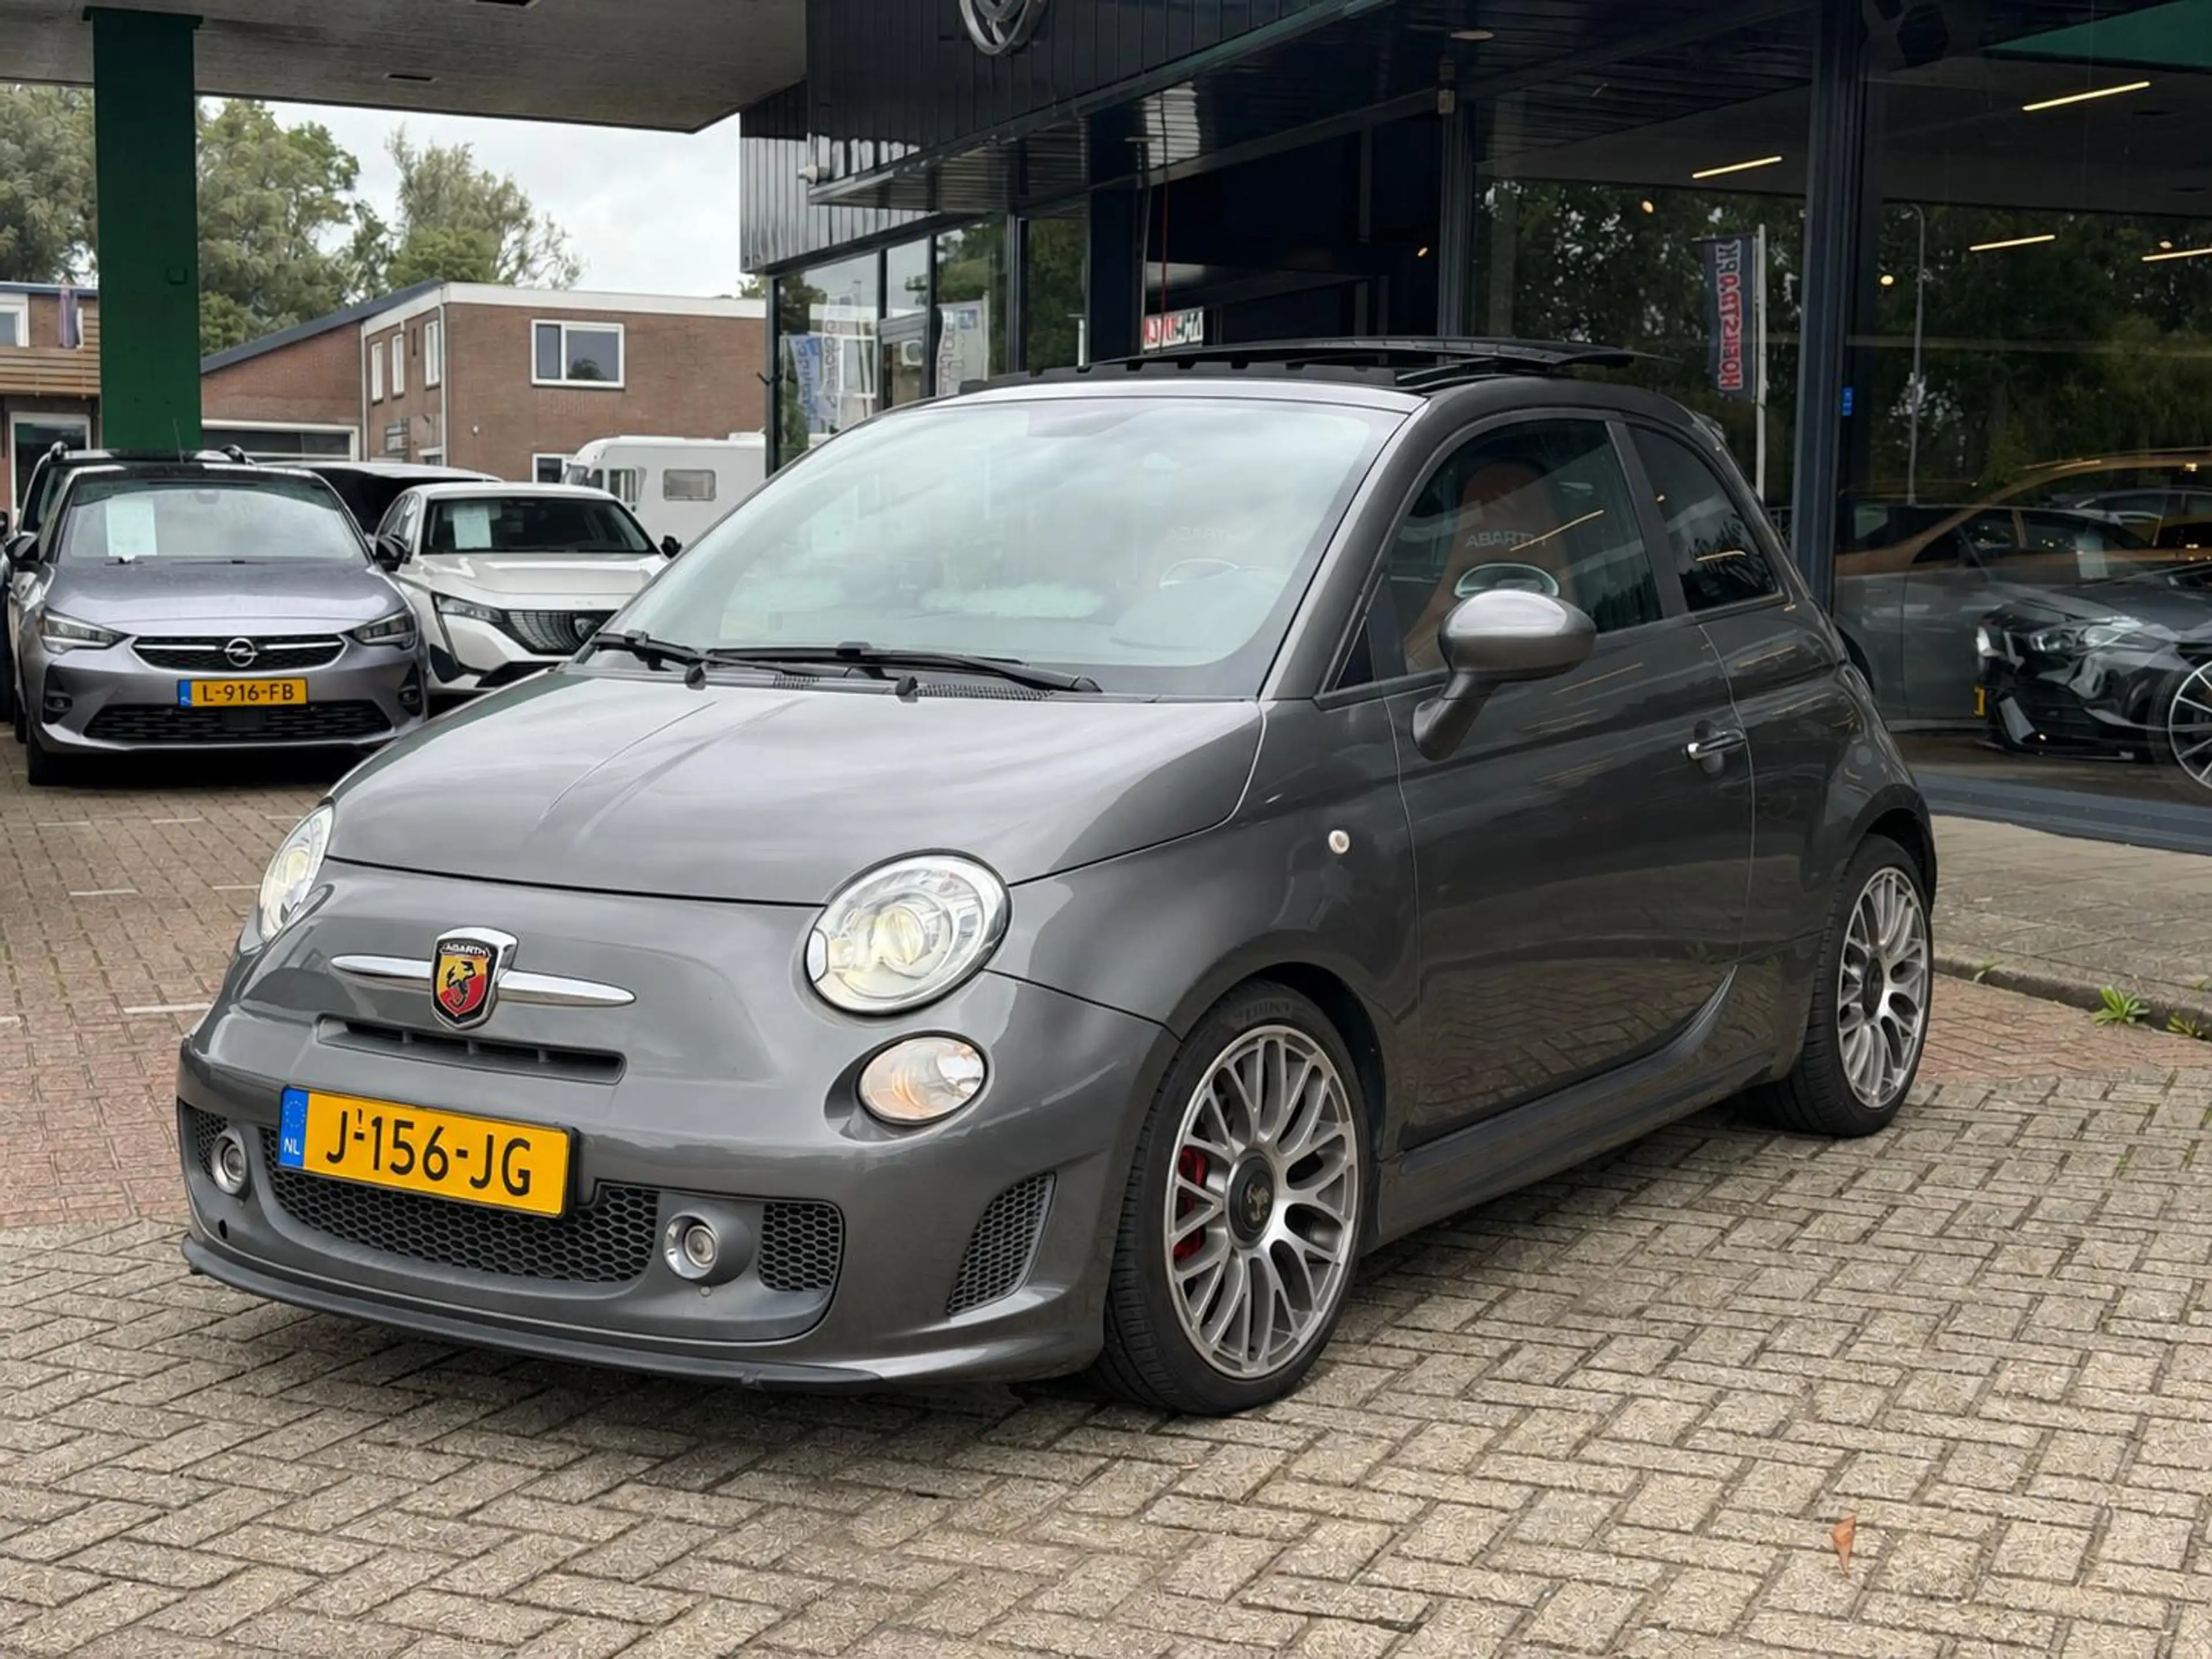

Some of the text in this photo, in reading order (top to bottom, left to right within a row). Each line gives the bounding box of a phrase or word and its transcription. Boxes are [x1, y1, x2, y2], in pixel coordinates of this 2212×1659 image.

[203, 684, 294, 702] L-916-FB
[284, 1138, 300, 1156] NL
[325, 1110, 531, 1197] J-156-JG
